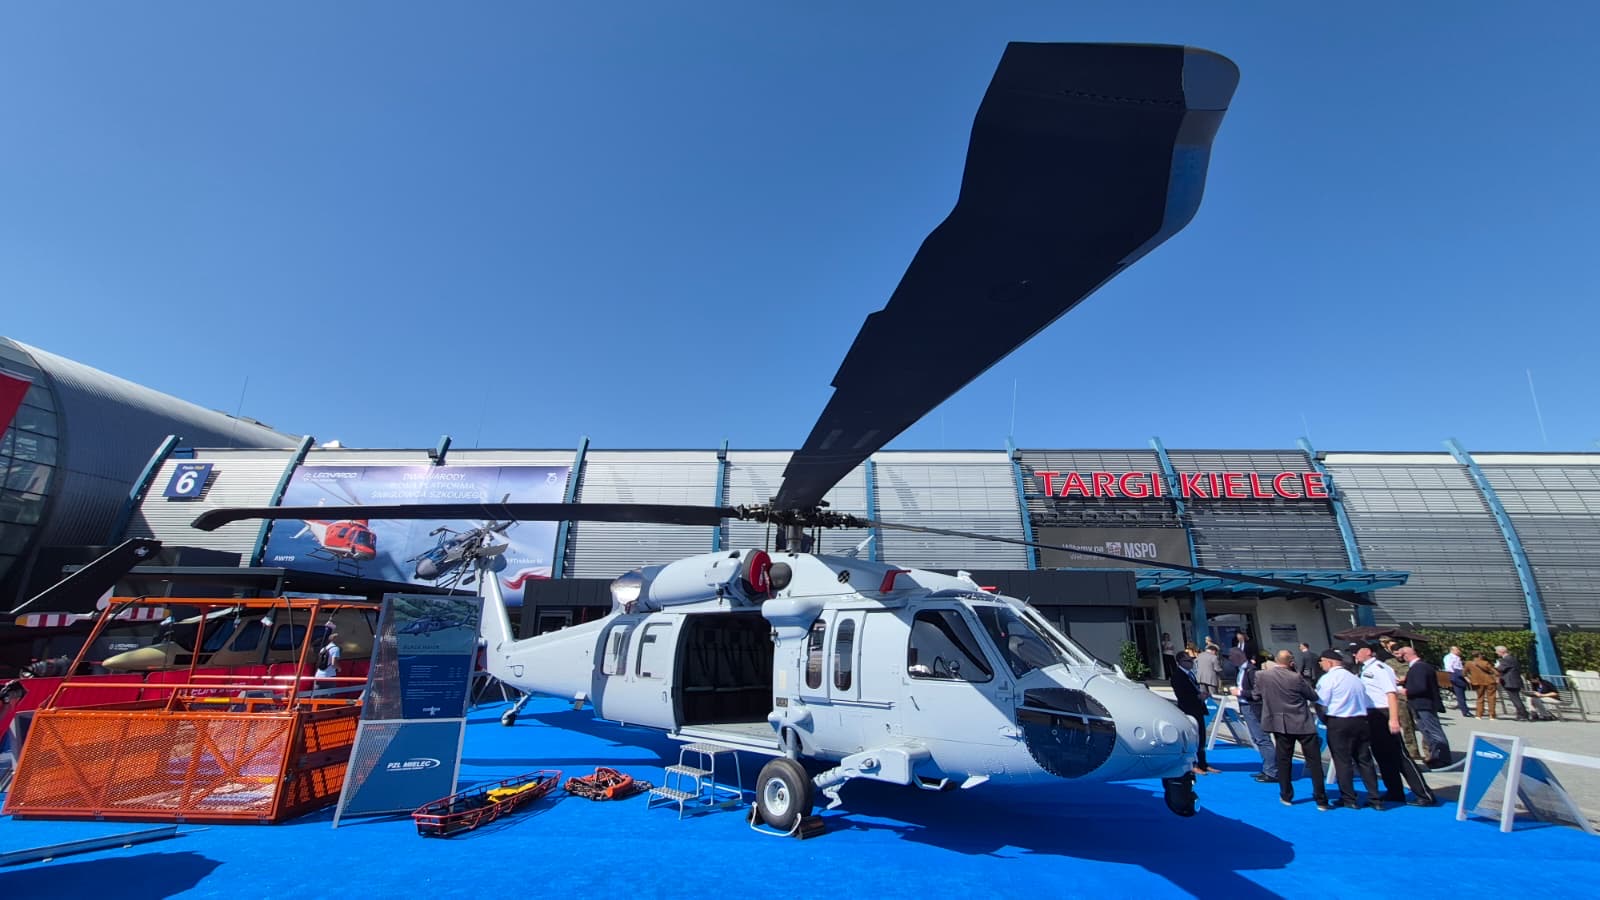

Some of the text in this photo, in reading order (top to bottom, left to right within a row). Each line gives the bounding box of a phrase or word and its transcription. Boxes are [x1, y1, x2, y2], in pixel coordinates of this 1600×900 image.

[176, 470, 198, 494] 6
[1034, 471, 1328, 498] TARGI KIELCE
[1123, 542, 1158, 559] MSPO
